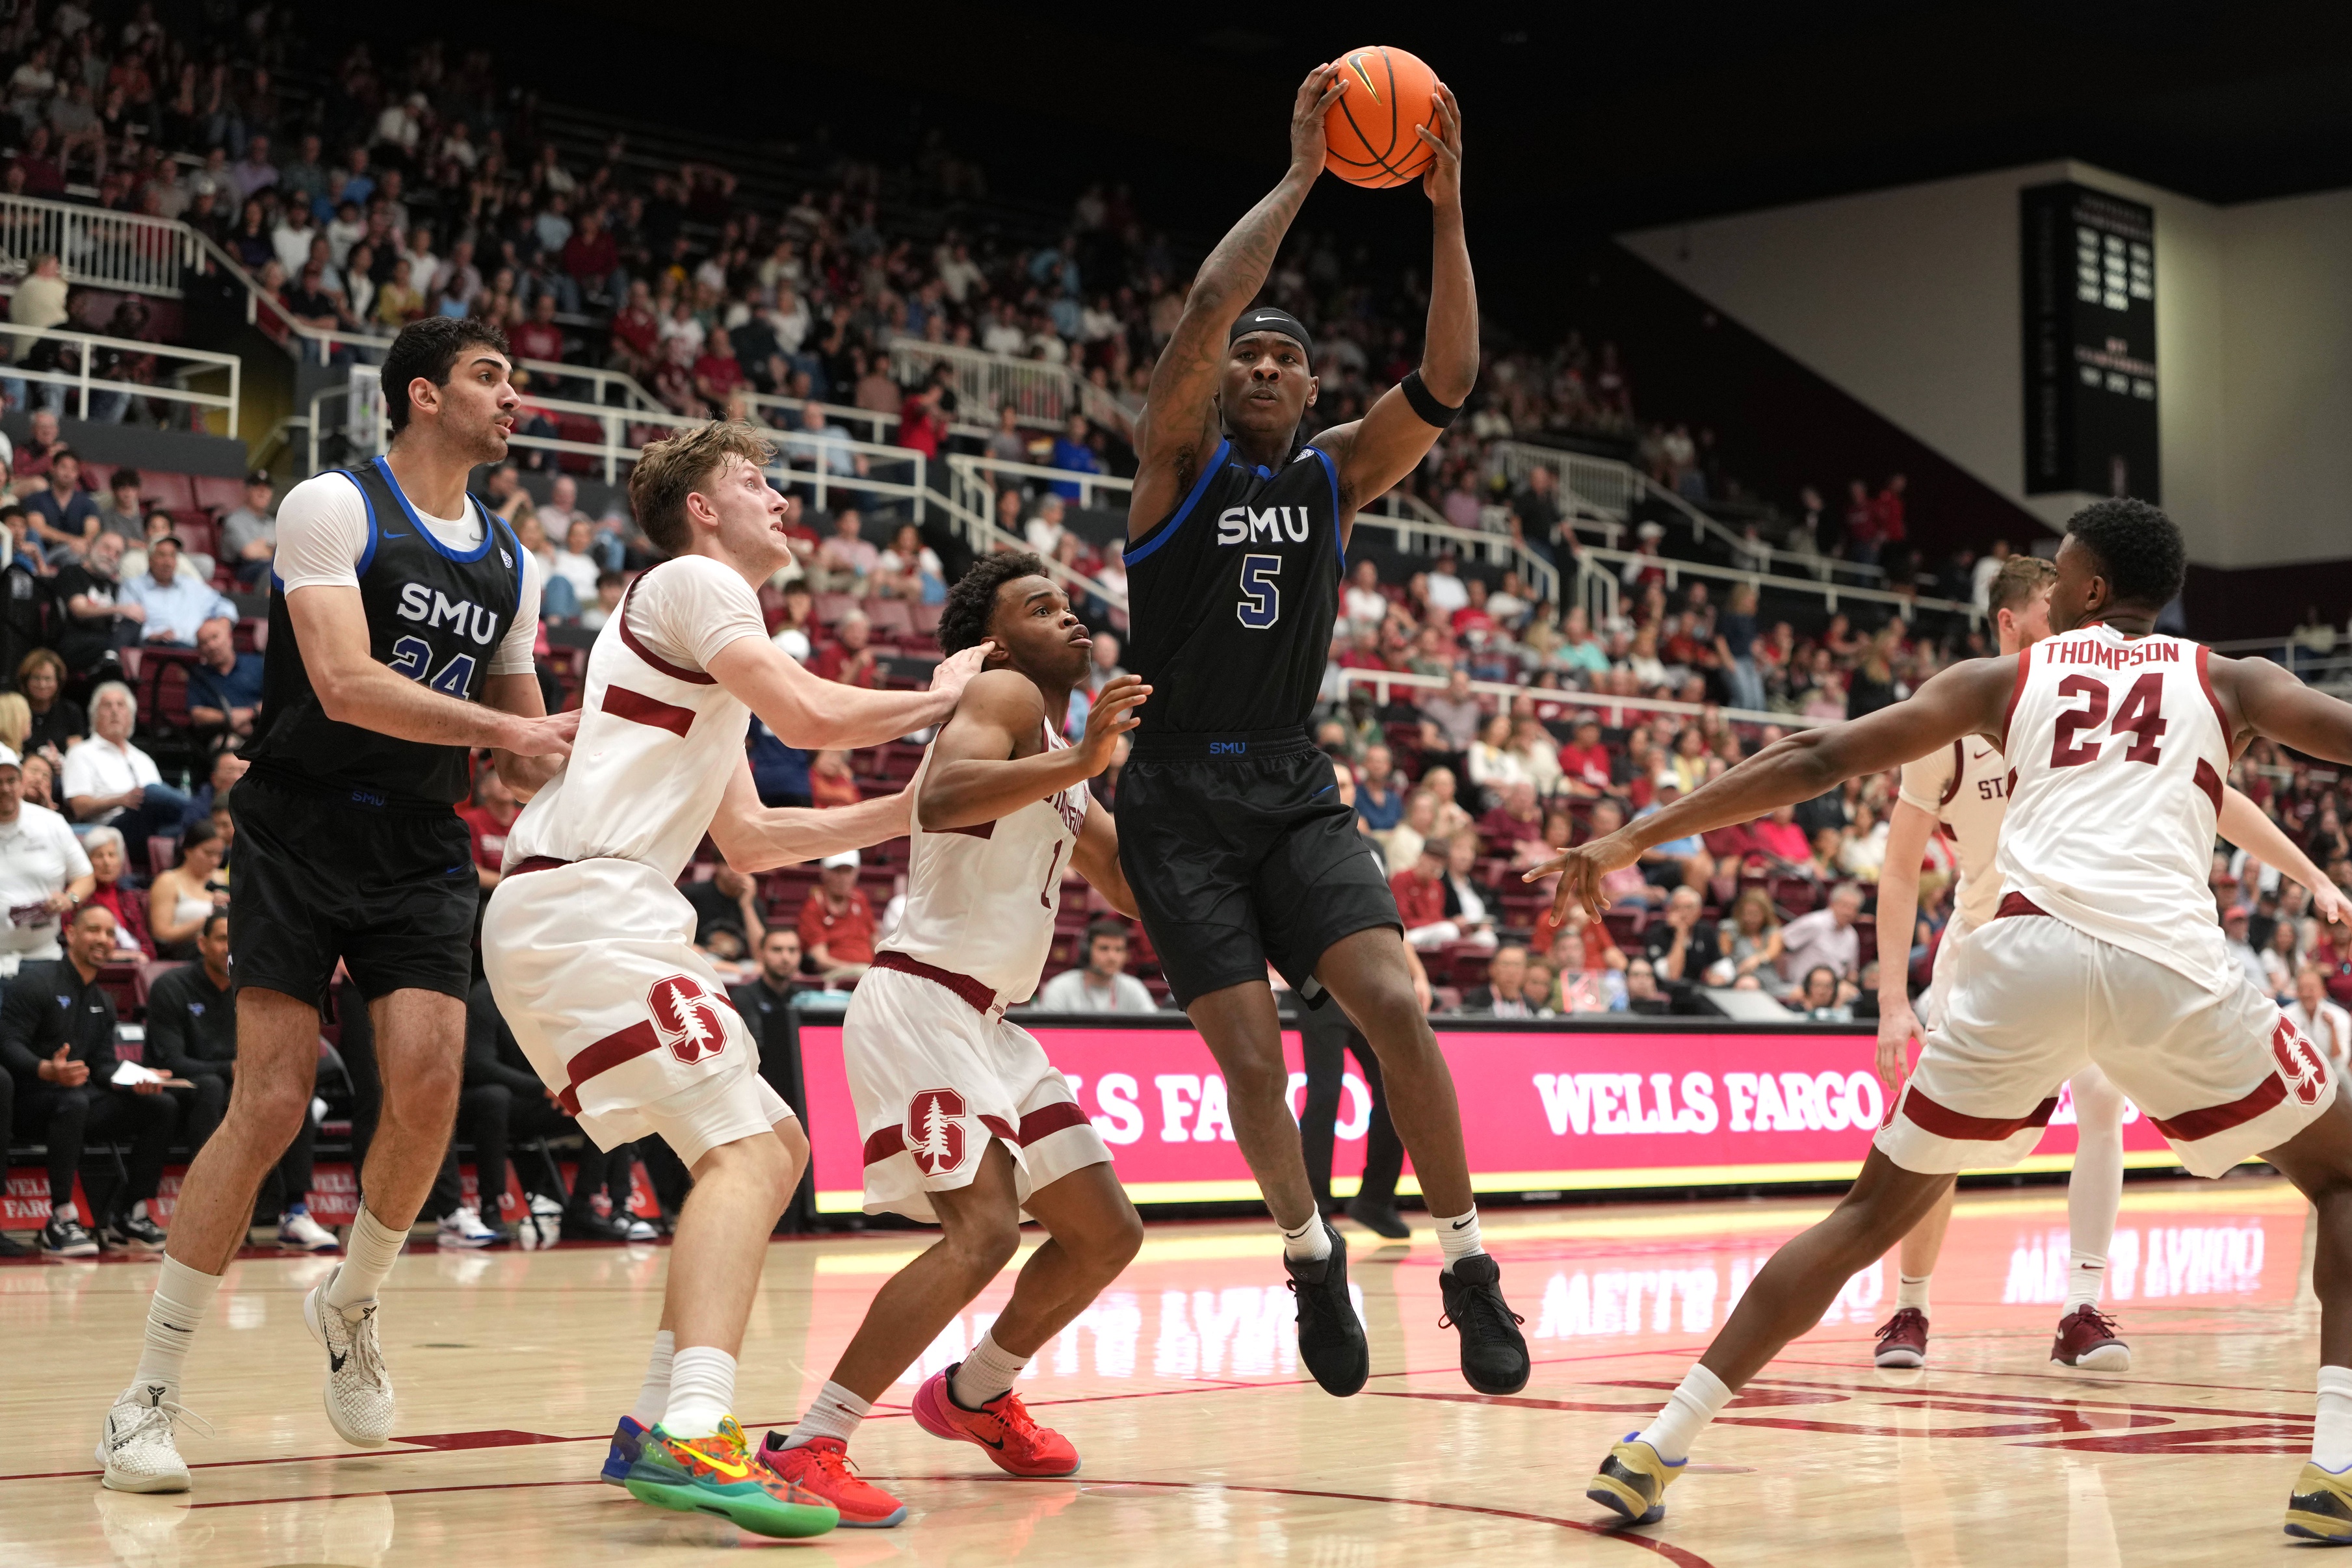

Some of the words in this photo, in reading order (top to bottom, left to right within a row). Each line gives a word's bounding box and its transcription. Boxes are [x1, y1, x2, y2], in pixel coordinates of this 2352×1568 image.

[1218, 506, 1309, 545] SMU
[397, 582, 498, 645] SMU
[1237, 553, 1282, 629] 5
[387, 634, 476, 700] 24
[2045, 640, 2179, 670] THOMPSON
[1209, 742, 1246, 754] SMU
[2050, 673, 2167, 768] 24
[352, 791, 385, 806] SMU
[1041, 839, 1062, 909] 1
[1533, 1072, 1719, 1135] WELLS
[1723, 1071, 1884, 1131] FARGO
